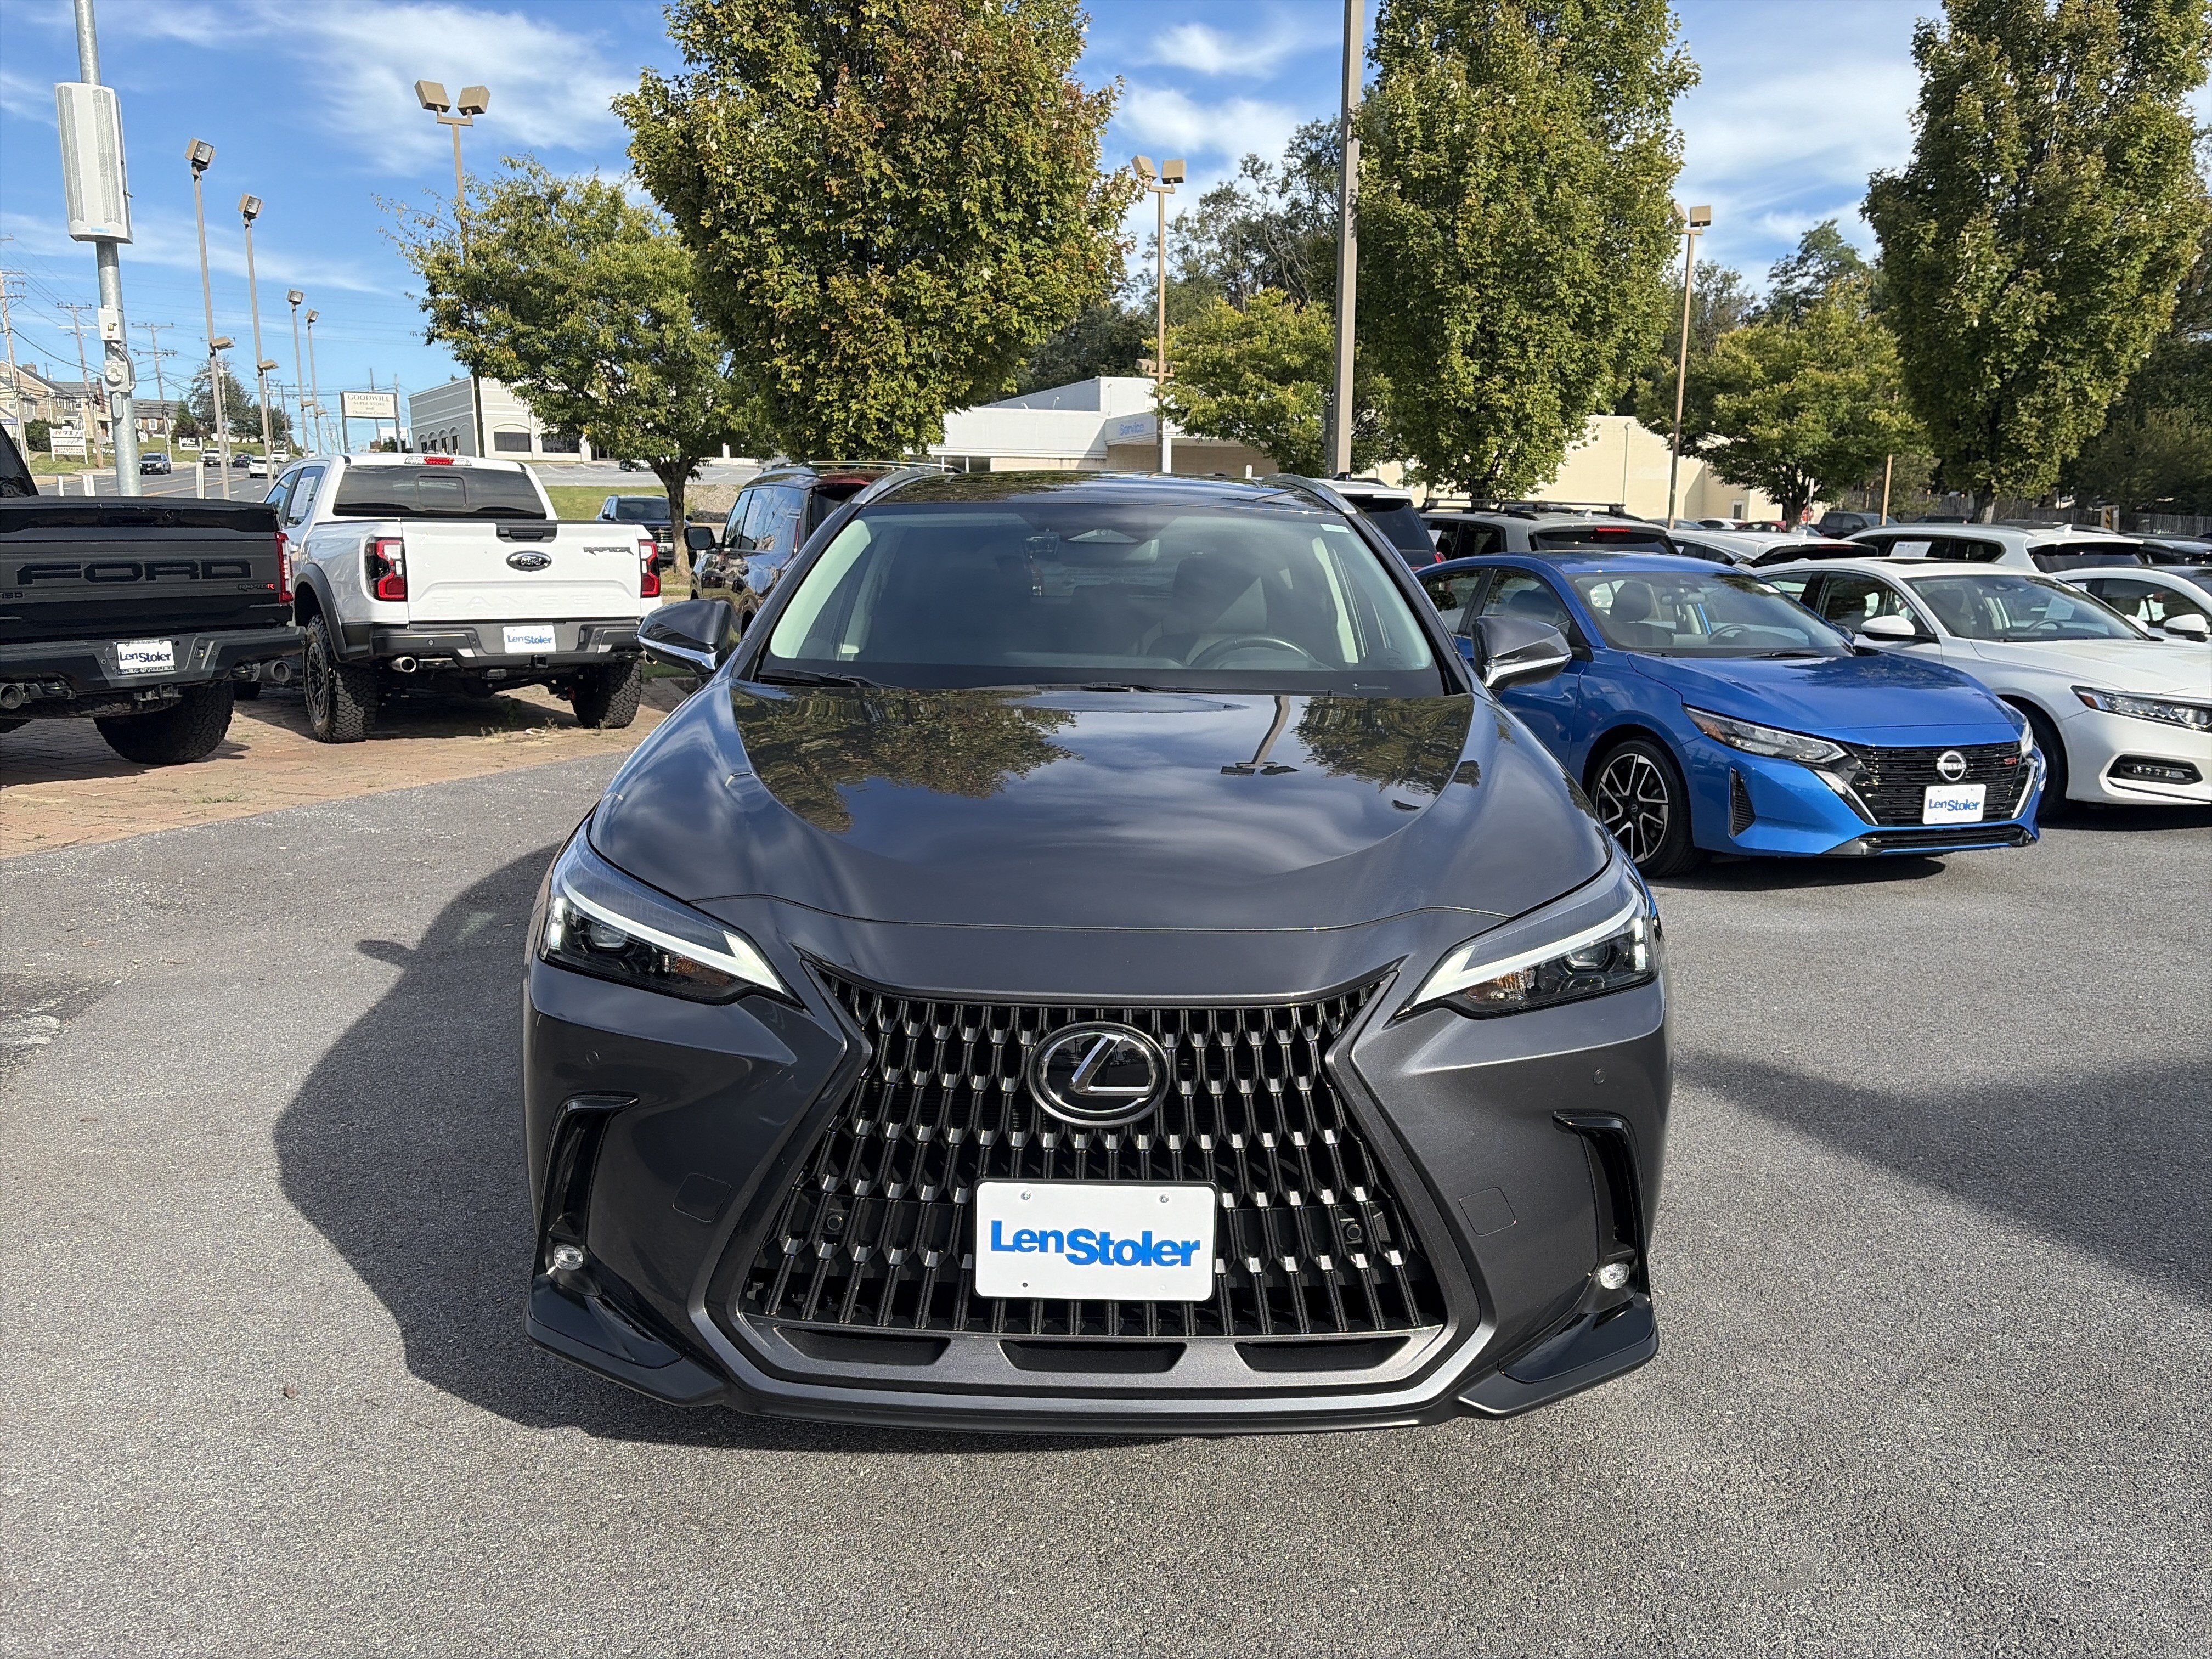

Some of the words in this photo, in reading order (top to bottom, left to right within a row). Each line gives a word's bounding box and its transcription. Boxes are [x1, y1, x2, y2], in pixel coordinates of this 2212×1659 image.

[1119, 422, 1145, 436] Service
[583, 546, 634, 556] RAPTOR
[17, 560, 252, 585] FORD
